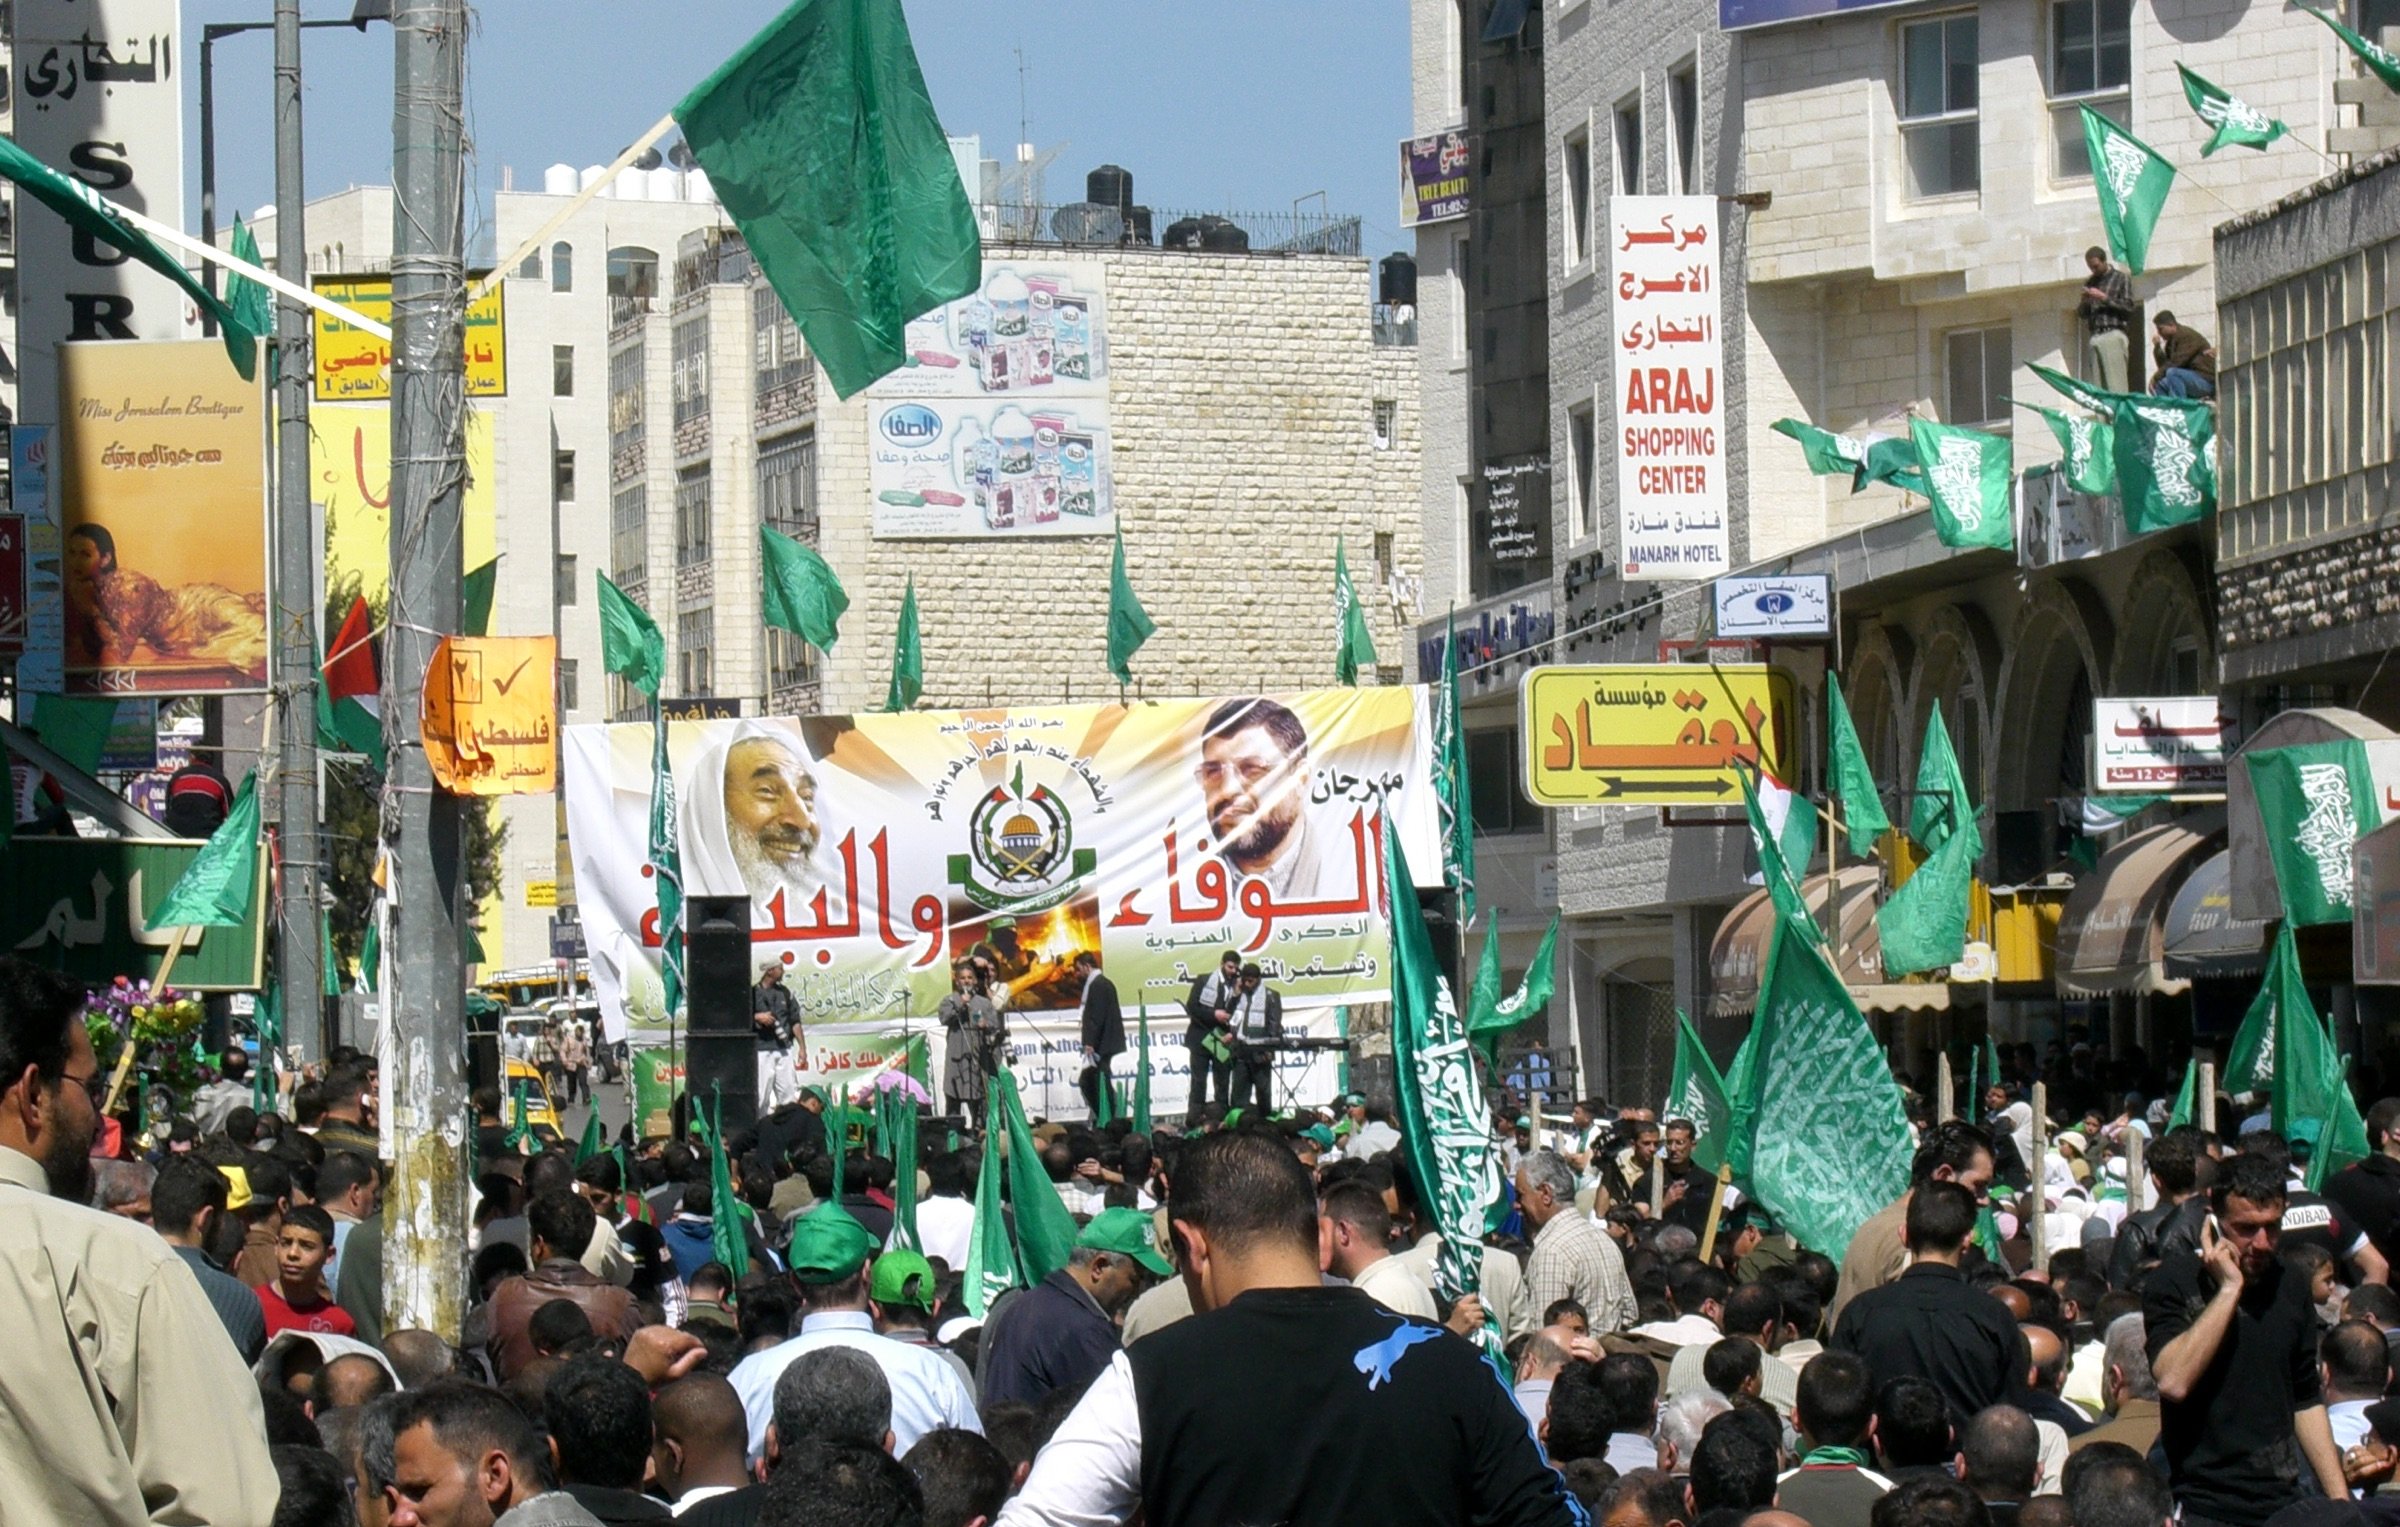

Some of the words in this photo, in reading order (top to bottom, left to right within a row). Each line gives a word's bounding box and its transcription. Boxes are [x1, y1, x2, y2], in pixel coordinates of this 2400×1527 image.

[24, 28, 171, 112] التجاري
[1619, 214, 1707, 252] مركز
[1619, 263, 1710, 301] الاعرج
[1622, 313, 1712, 356] التجاري
[1625, 367, 1714, 415] ARAJ
[79, 397, 112, 420] Miss
[114, 396, 182, 423] Jerusalem
[185, 395, 244, 420] Boutique
[889, 414, 934, 438] الصفا
[1624, 426, 1715, 458] SHOPPING
[1638, 465, 1707, 495] CENTER
[1628, 511, 1669, 534] منارة
[1673, 510, 1721, 534] فندق
[1629, 545, 1680, 564] MANARH
[1684, 544, 1722, 563] HOTEL
[1594, 680, 1667, 710] مؤسسة
[940, 720, 974, 734] الرحيم
[1018, 718, 1037, 728] الله
[1544, 688, 1786, 771] العقاد
[2113, 703, 2238, 737] خلف
[985, 736, 1009, 759] لهم
[1013, 738, 1043, 757] ربهم
[1046, 746, 1069, 762] عند
[1311, 767, 1405, 805] مهرجان
[2111, 766, 2134, 780] سنة
[2136, 769, 2152, 780] 12
[1146, 926, 1233, 952] السنوية
[1277, 918, 1369, 944] الذكرى
[855, 1051, 884, 1069] ملك
